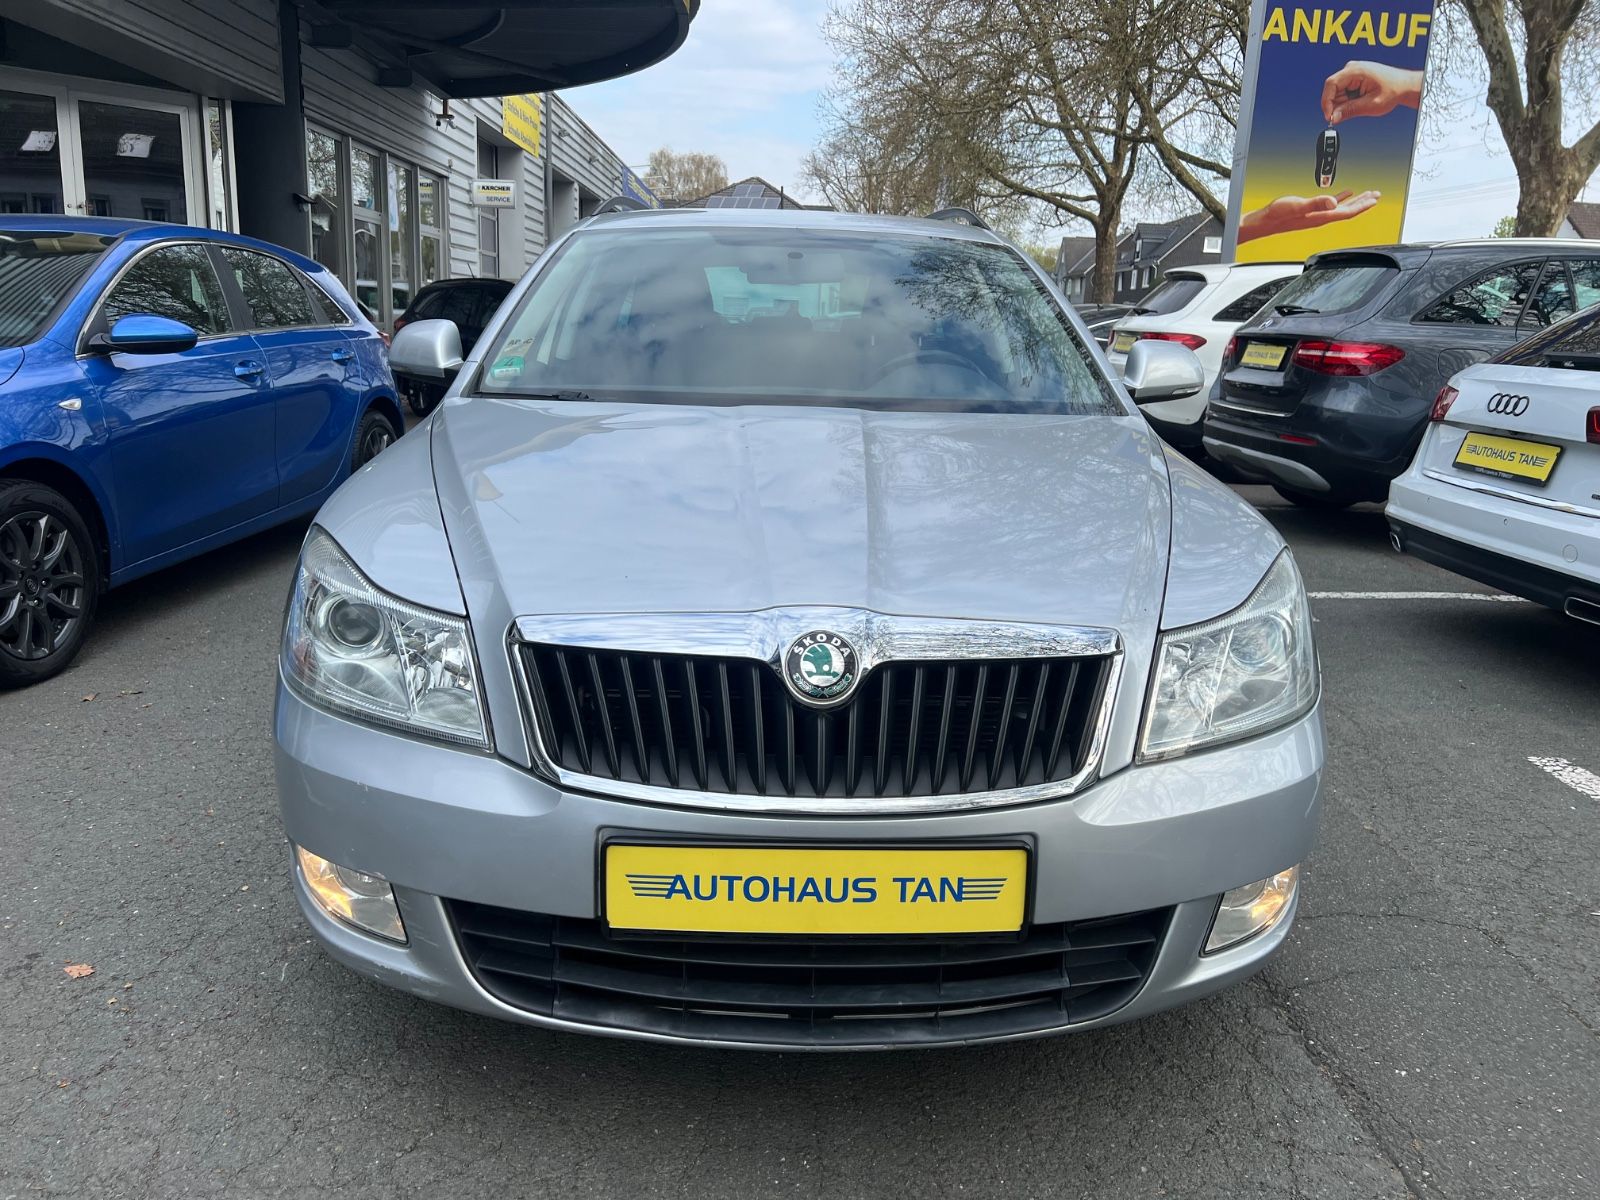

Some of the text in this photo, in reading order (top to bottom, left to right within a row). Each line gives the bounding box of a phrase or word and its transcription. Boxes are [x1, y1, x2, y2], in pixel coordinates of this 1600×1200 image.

[1262, 7, 1431, 47] ANKAUF
[1471, 444, 1537, 466] AUTOHAUS TAN
[665, 874, 963, 903] AUTOHAUS TAN
